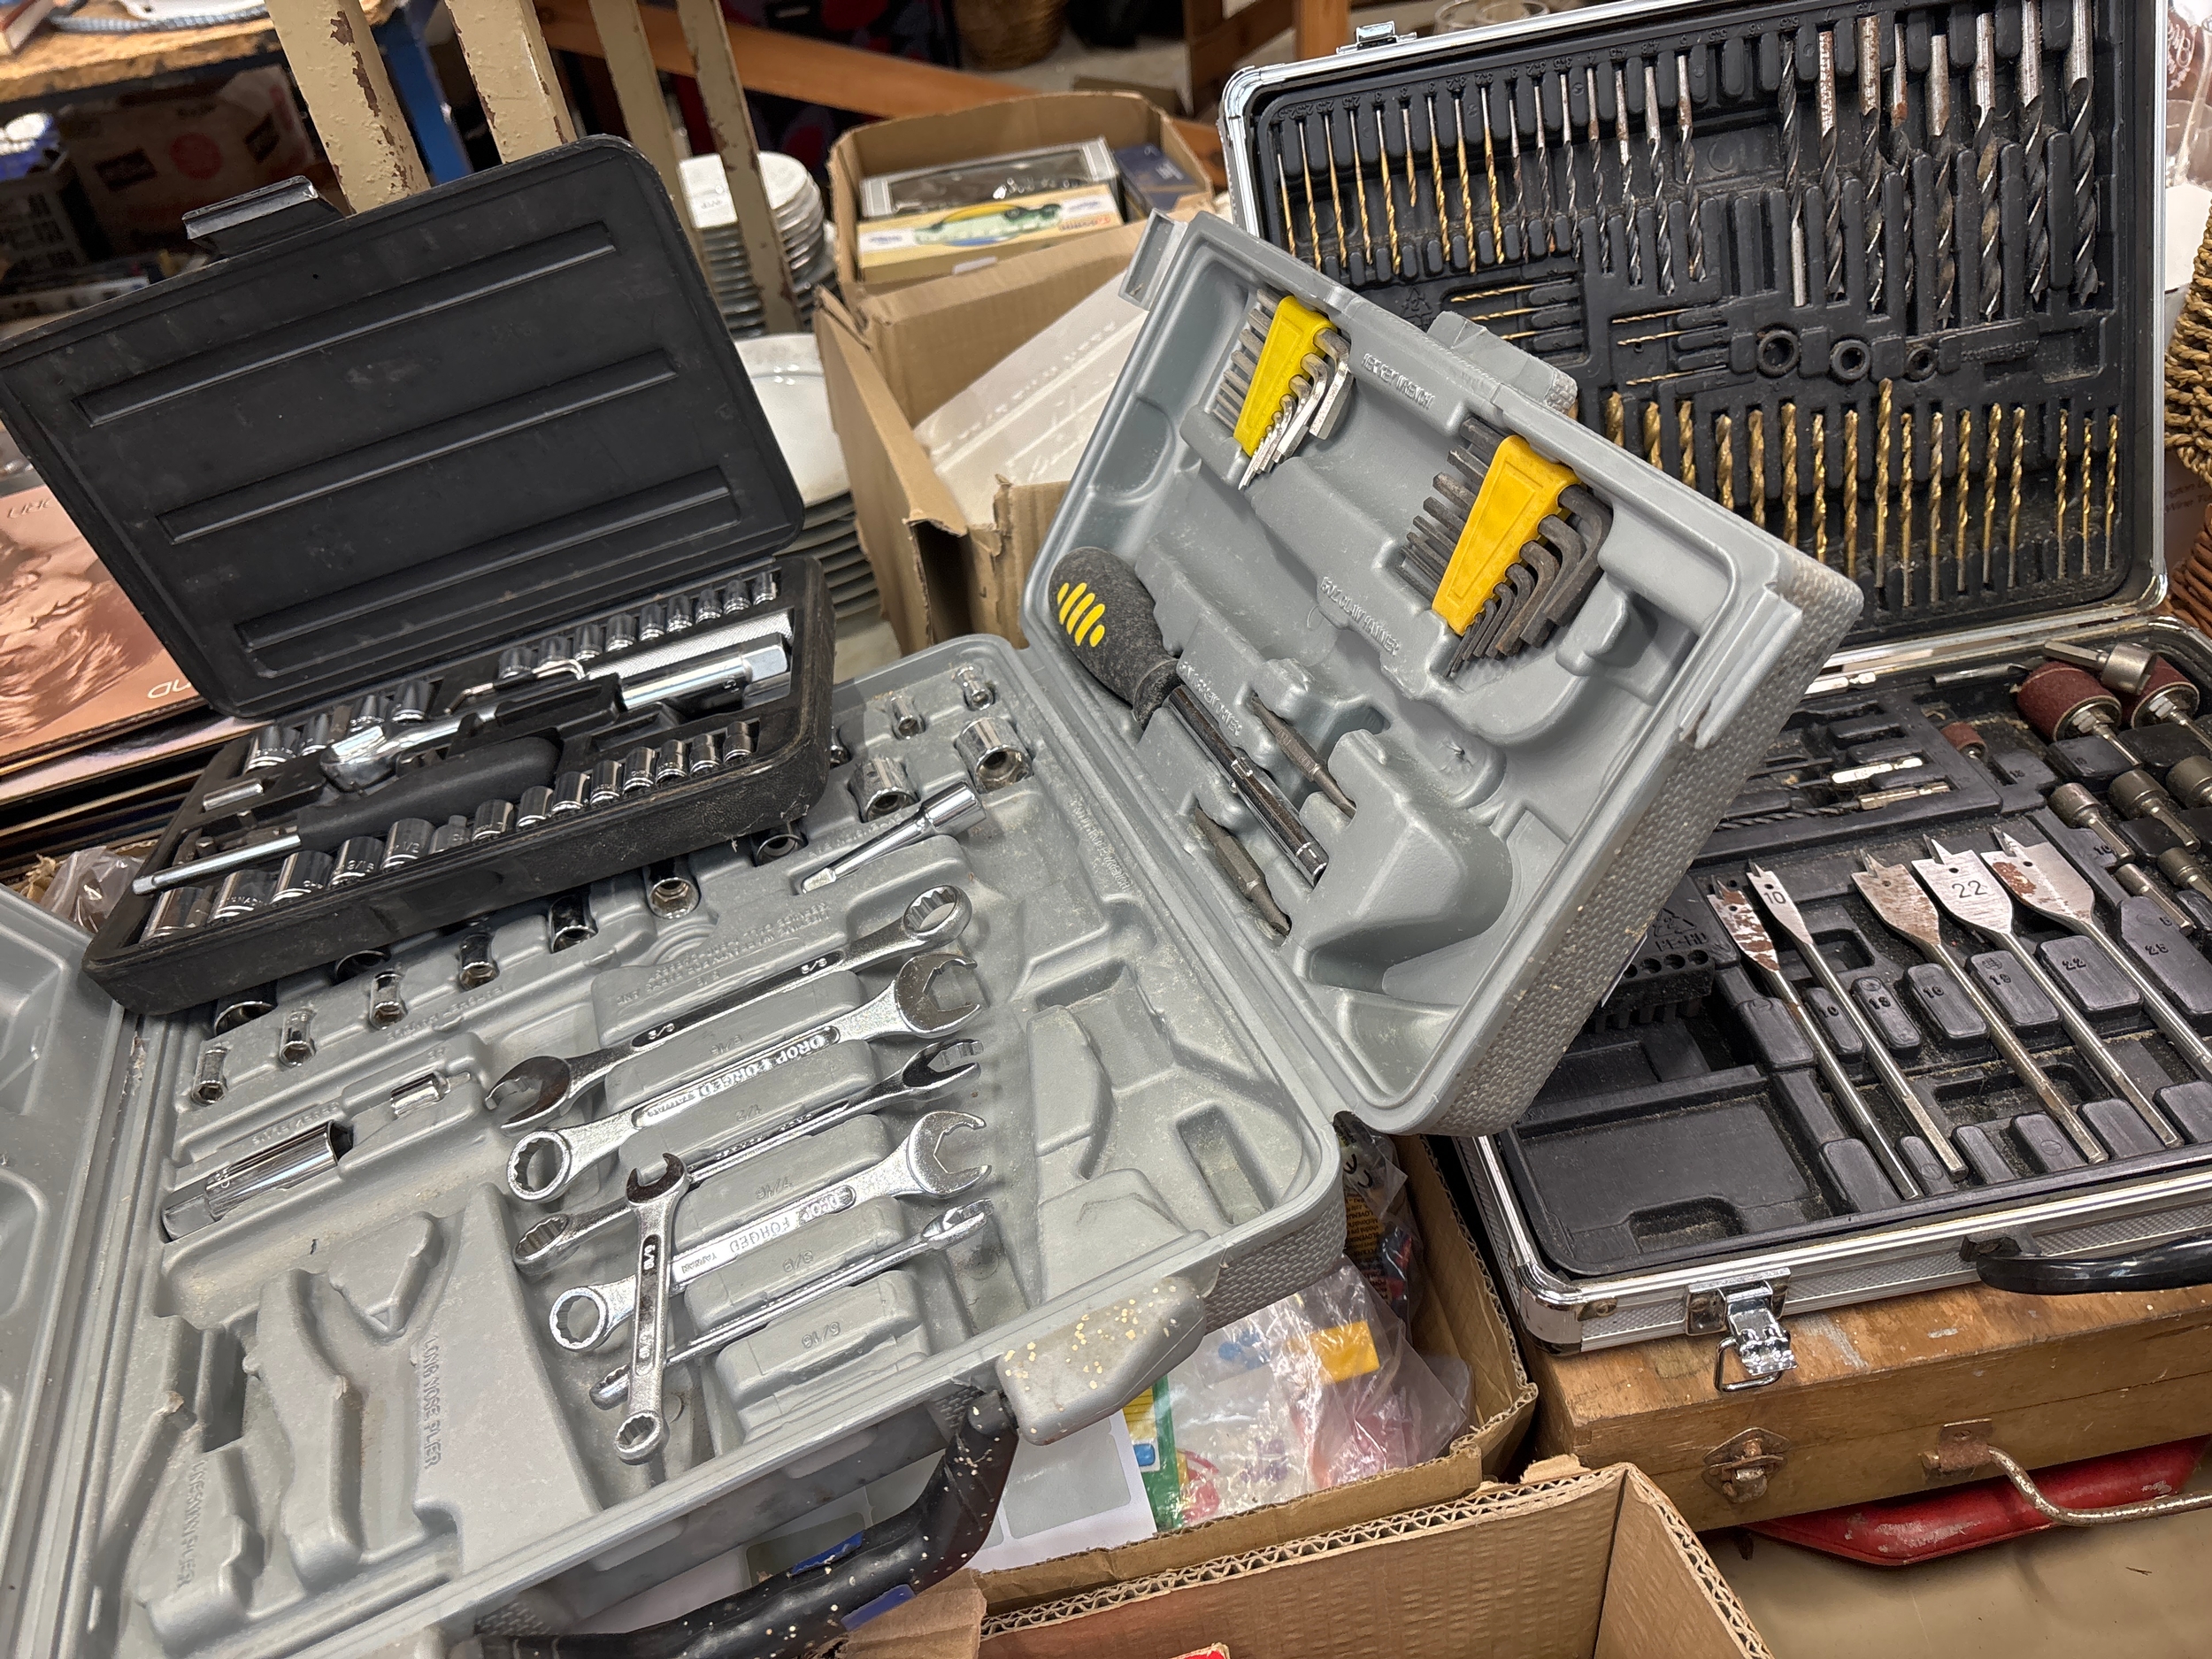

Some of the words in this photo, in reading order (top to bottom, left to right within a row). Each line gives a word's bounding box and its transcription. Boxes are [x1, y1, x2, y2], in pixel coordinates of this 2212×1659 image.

[1762, 890, 1787, 908] 10
[1951, 880, 1988, 900] 22
[773, 1033, 826, 1065] DROP
[697, 1056, 773, 1098] FORGED
[728, 1217, 792, 1254] FORGED
